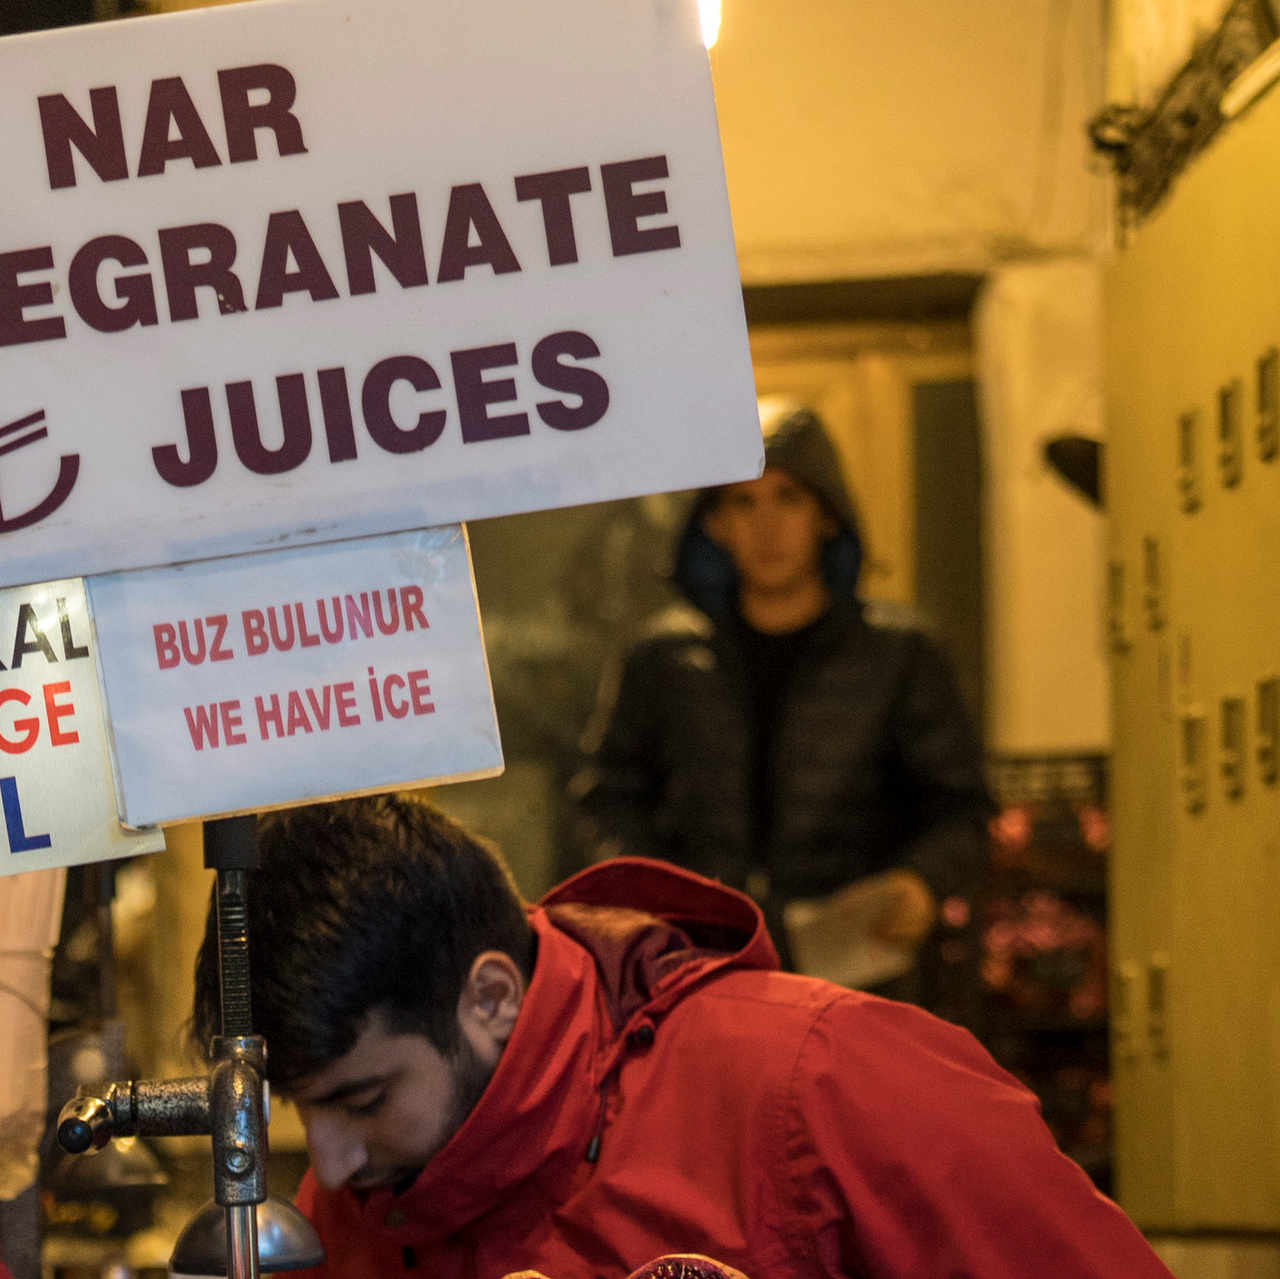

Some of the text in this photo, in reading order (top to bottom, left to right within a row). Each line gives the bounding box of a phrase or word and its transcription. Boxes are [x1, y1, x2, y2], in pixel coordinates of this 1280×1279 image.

[37, 62, 309, 191] NAR
[151, 328, 610, 488] JUICES
[152, 584, 430, 670] BUZ BULUNUR
[183, 665, 436, 752] WE HAVE İCE
